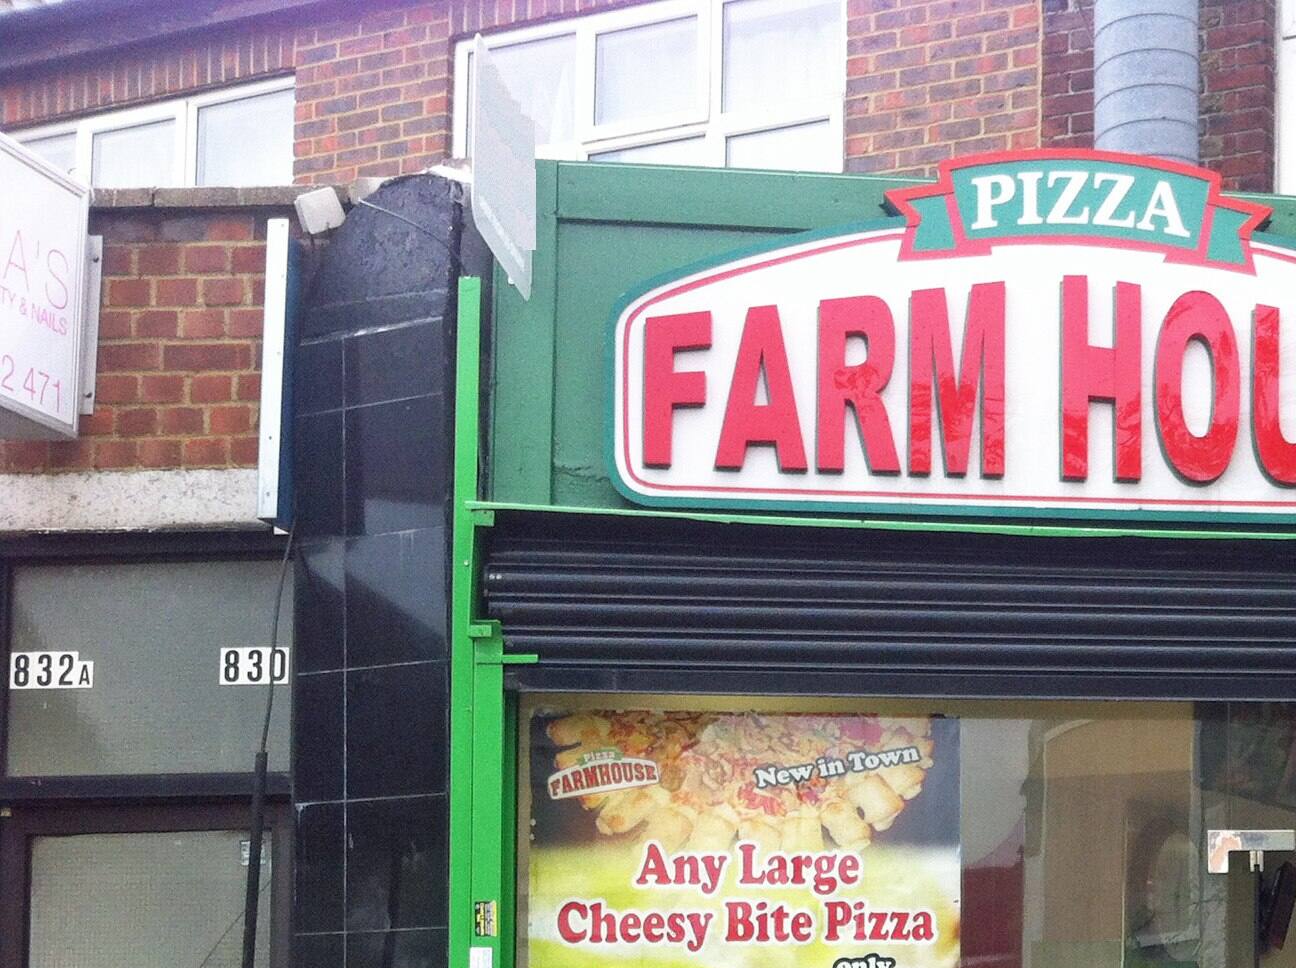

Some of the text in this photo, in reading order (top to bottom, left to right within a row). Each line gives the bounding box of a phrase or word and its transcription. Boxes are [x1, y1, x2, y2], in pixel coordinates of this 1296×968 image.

[970, 170, 1192, 239] PIZZA
[31, 303, 68, 336] NAILS
[23, 367, 62, 413] 471
[641, 281, 1006, 480] FARM
[14, 654, 91, 687] 832A
[223, 649, 287, 683] 830
[549, 762, 658, 797] FARMHOUSE
[755, 746, 921, 789] New in Town
[636, 842, 860, 895] Any Large
[557, 900, 936, 951] Cheesy Bite Pizza
